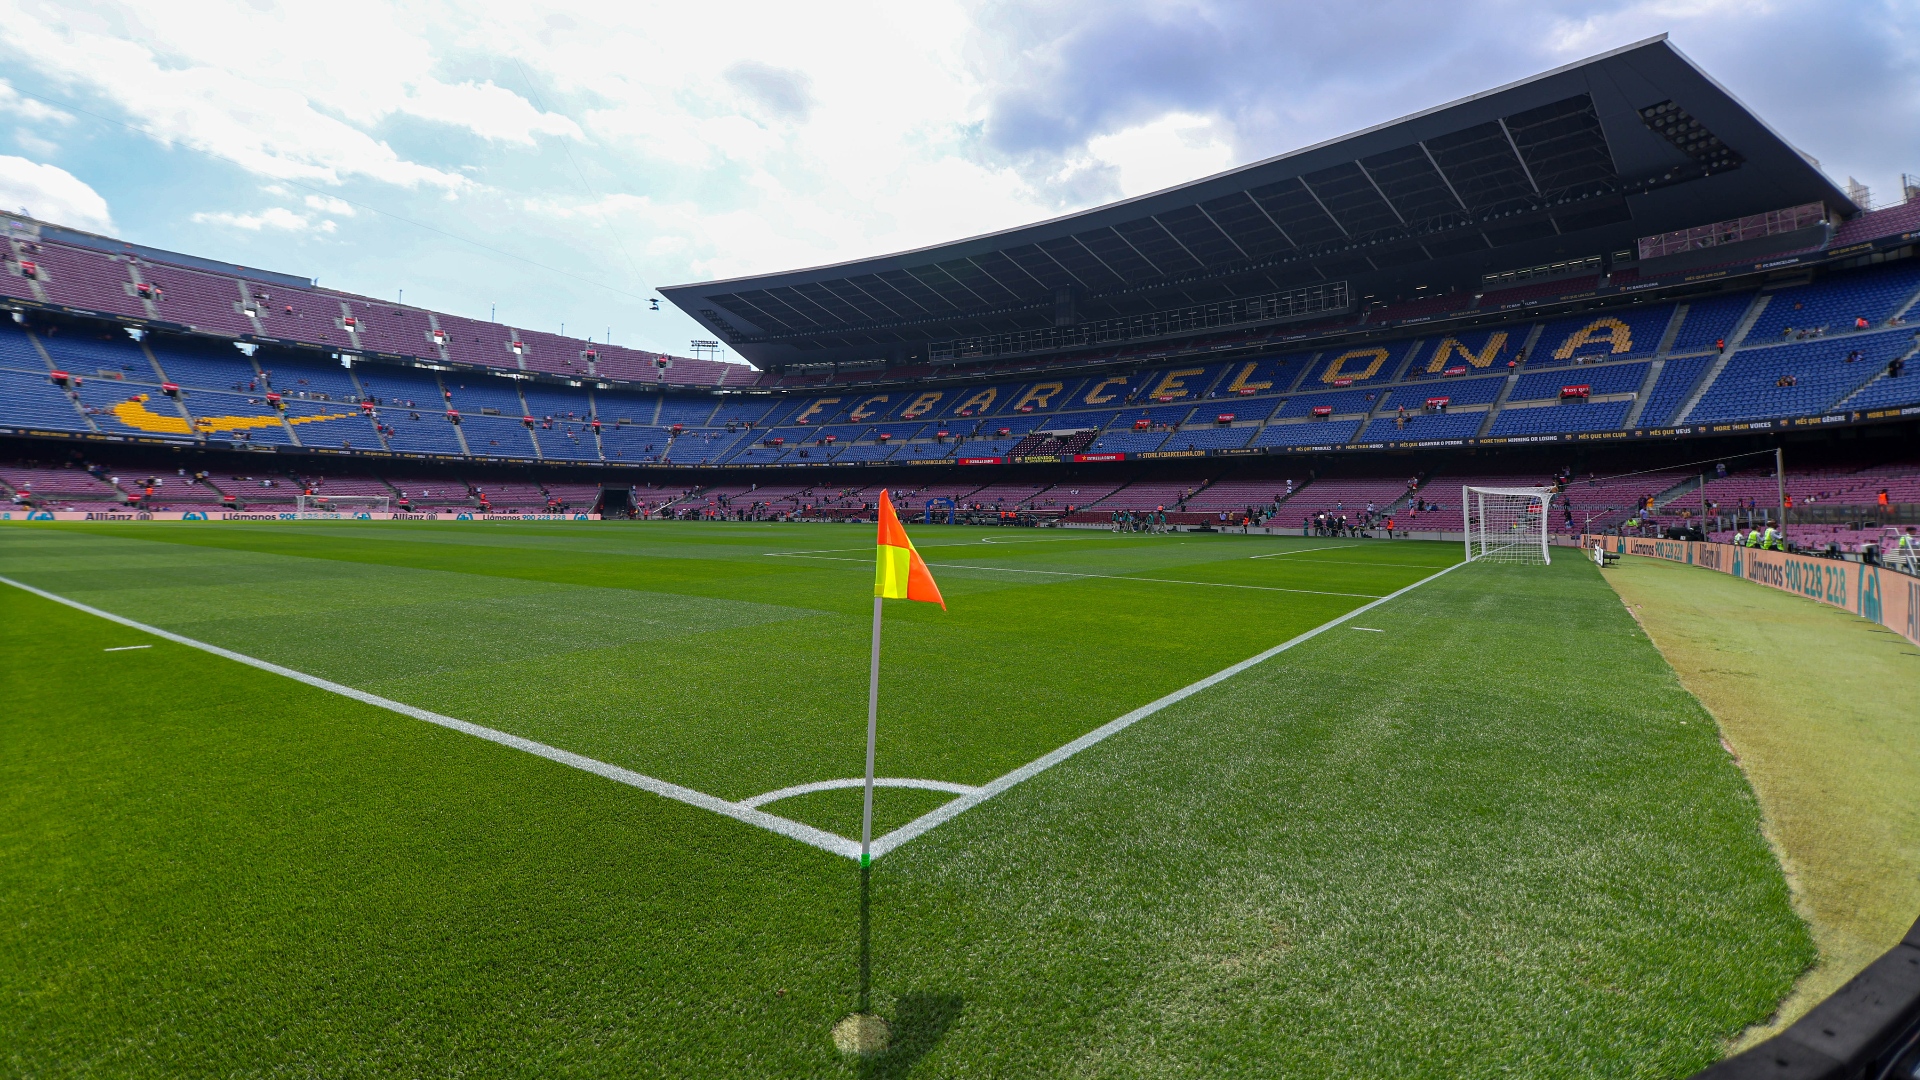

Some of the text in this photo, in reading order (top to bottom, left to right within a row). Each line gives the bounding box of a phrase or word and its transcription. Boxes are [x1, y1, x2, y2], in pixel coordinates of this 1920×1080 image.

[900, 317, 1632, 420] BARCELONA
[1795, 418, 1807, 426] MÉS
[1631, 540, 1683, 561] Llámanos 900 228 228
[1699, 543, 1714, 568] Allianz
[1749, 552, 1846, 606] Llámanos 900 228 228
